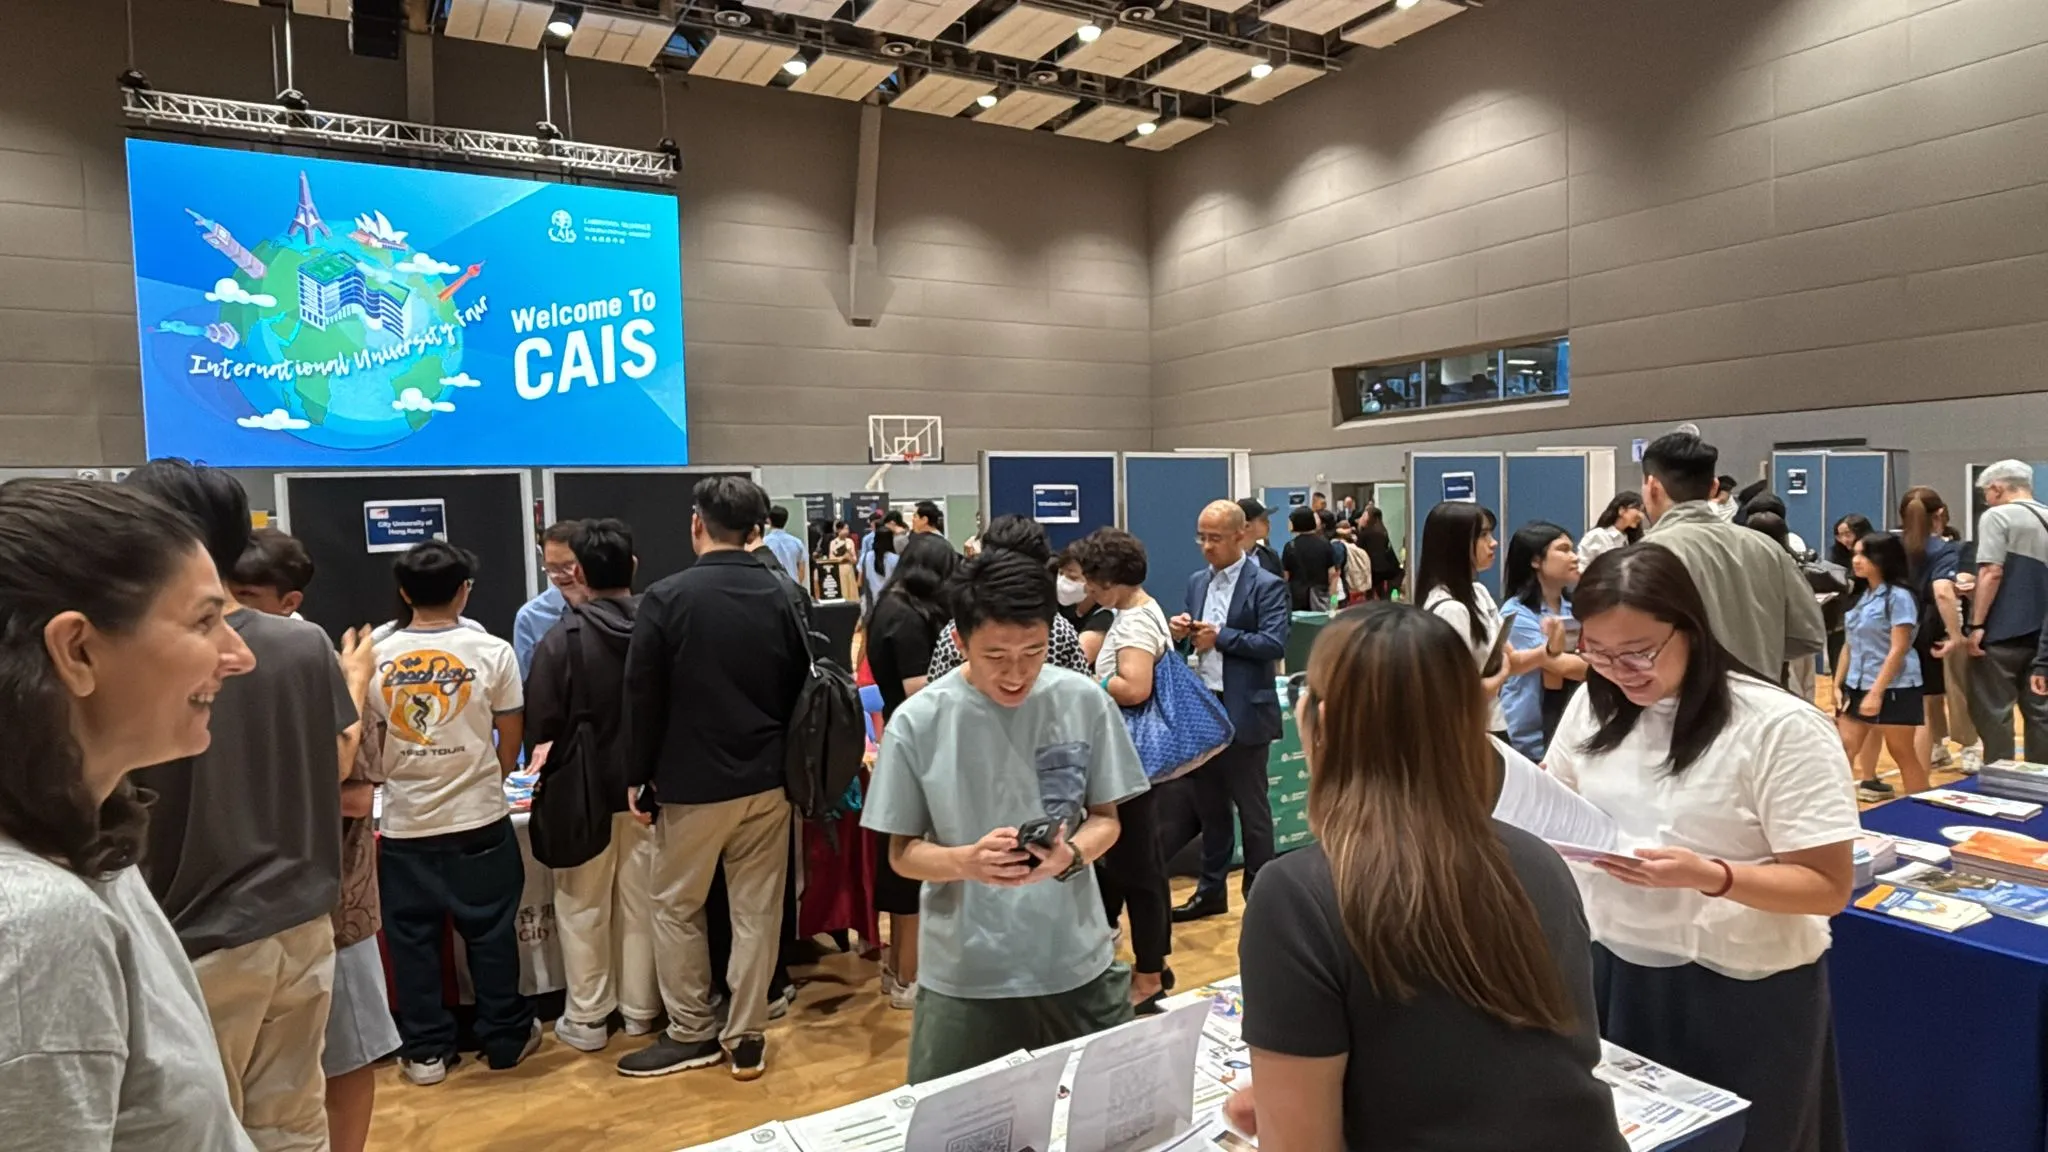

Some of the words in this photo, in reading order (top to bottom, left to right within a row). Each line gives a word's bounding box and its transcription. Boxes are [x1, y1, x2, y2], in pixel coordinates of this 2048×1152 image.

[511, 296, 622, 334] Welcome
[628, 288, 656, 313] To
[189, 351, 350, 381] International
[353, 323, 456, 369] University
[453, 295, 488, 327] Fair
[514, 318, 657, 400] CAIS
[388, 528, 406, 536] Hong
[392, 519, 425, 527] University
[430, 746, 465, 756] TOUR
